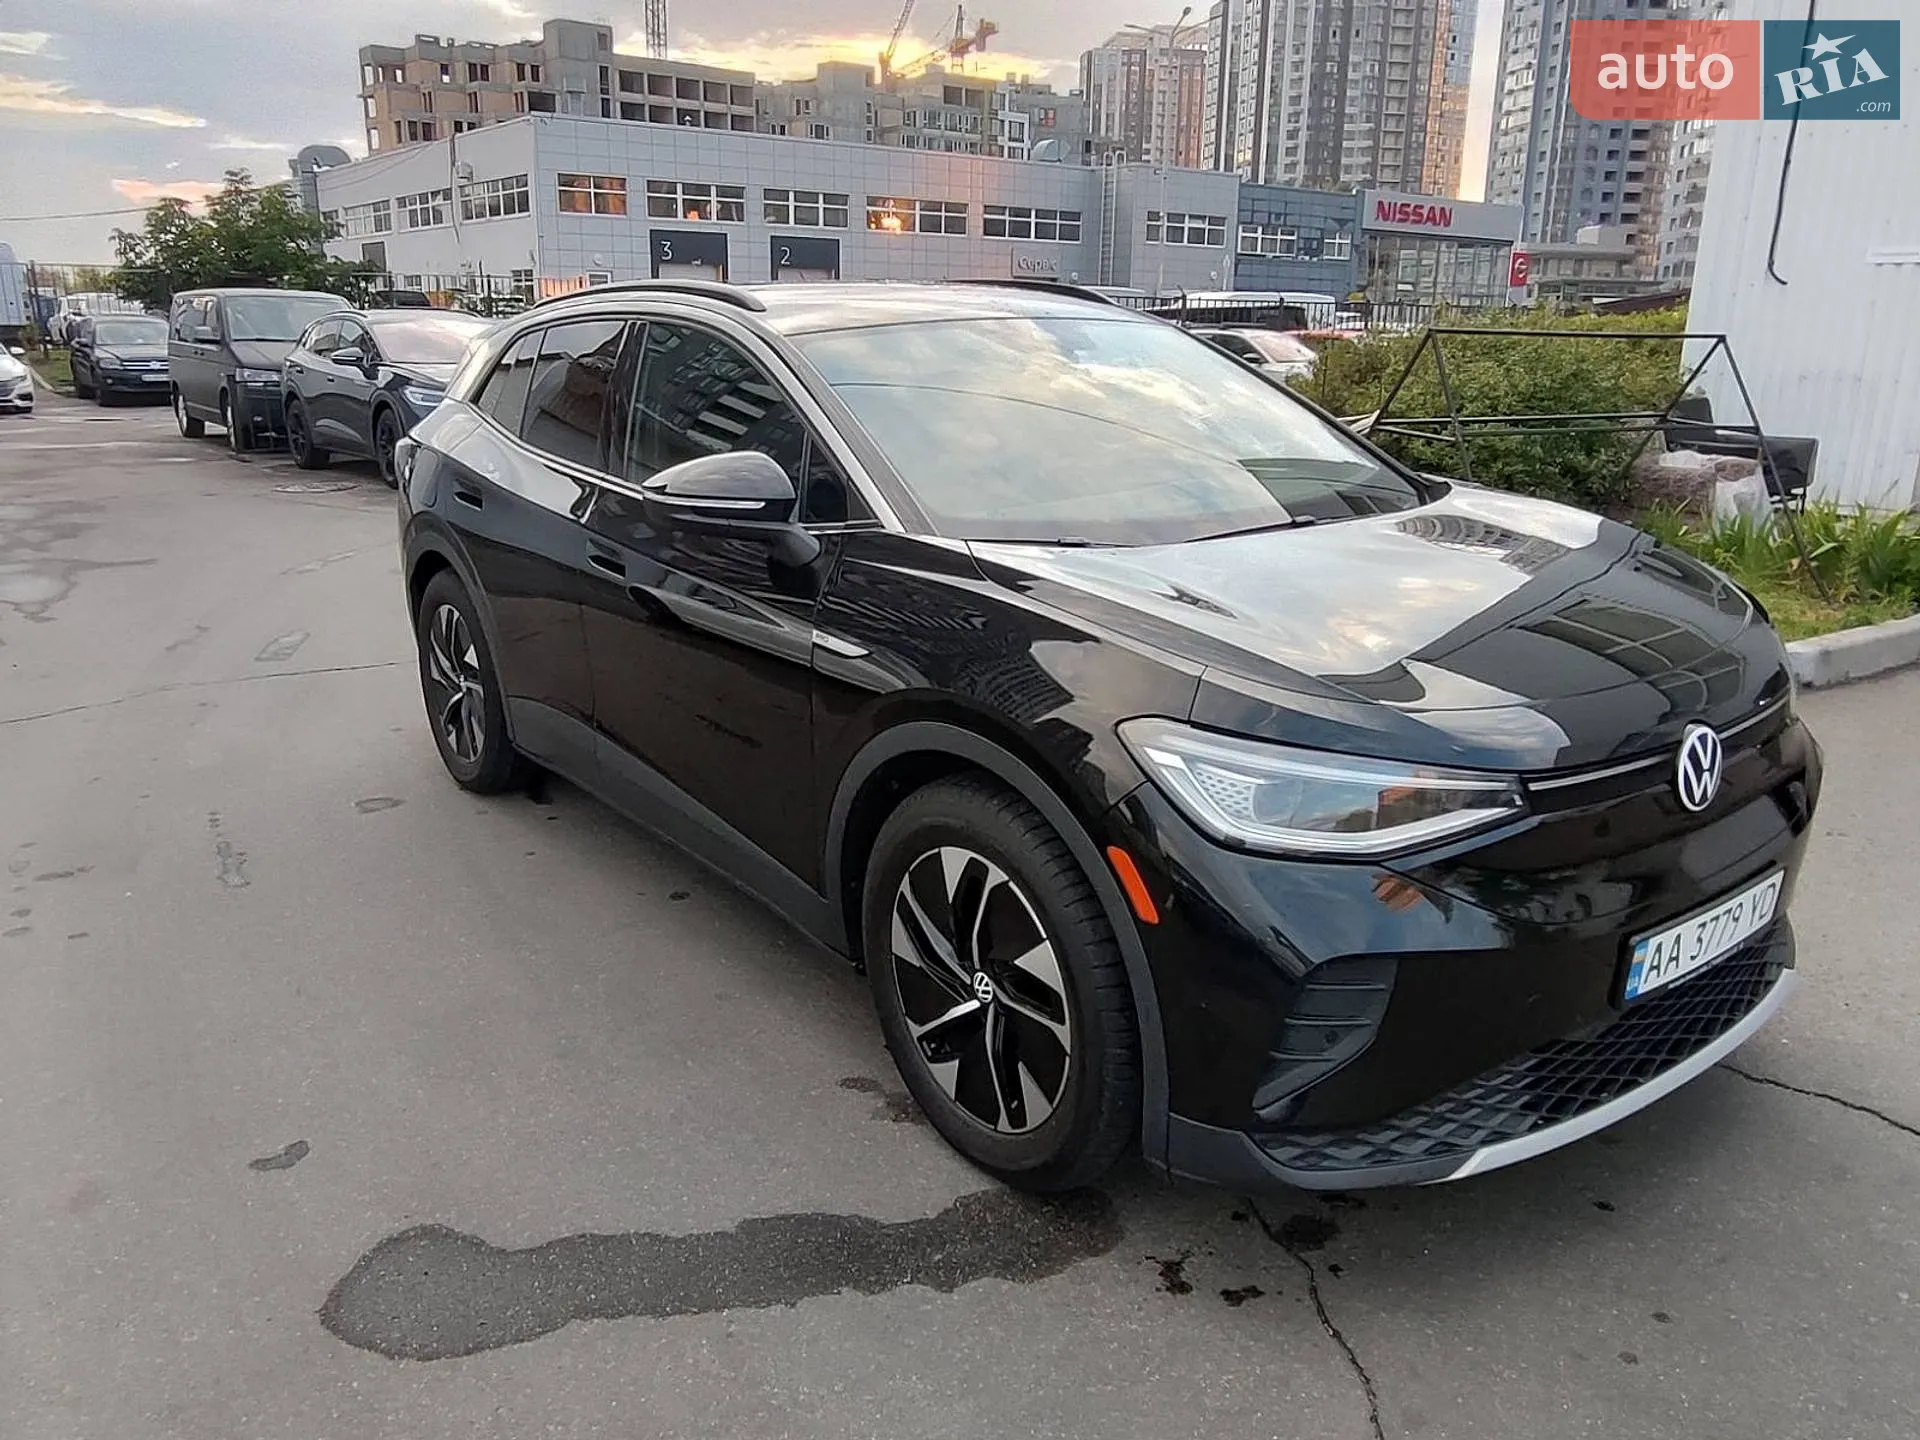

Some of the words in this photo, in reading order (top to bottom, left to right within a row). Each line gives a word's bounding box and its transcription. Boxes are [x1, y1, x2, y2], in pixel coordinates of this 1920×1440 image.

[1375, 200, 1453, 228] NISSAN
[659, 241, 673, 260] 3
[780, 247, 791, 265] 2
[1643, 932, 1682, 985] AA
[1690, 902, 1744, 962] 3779
